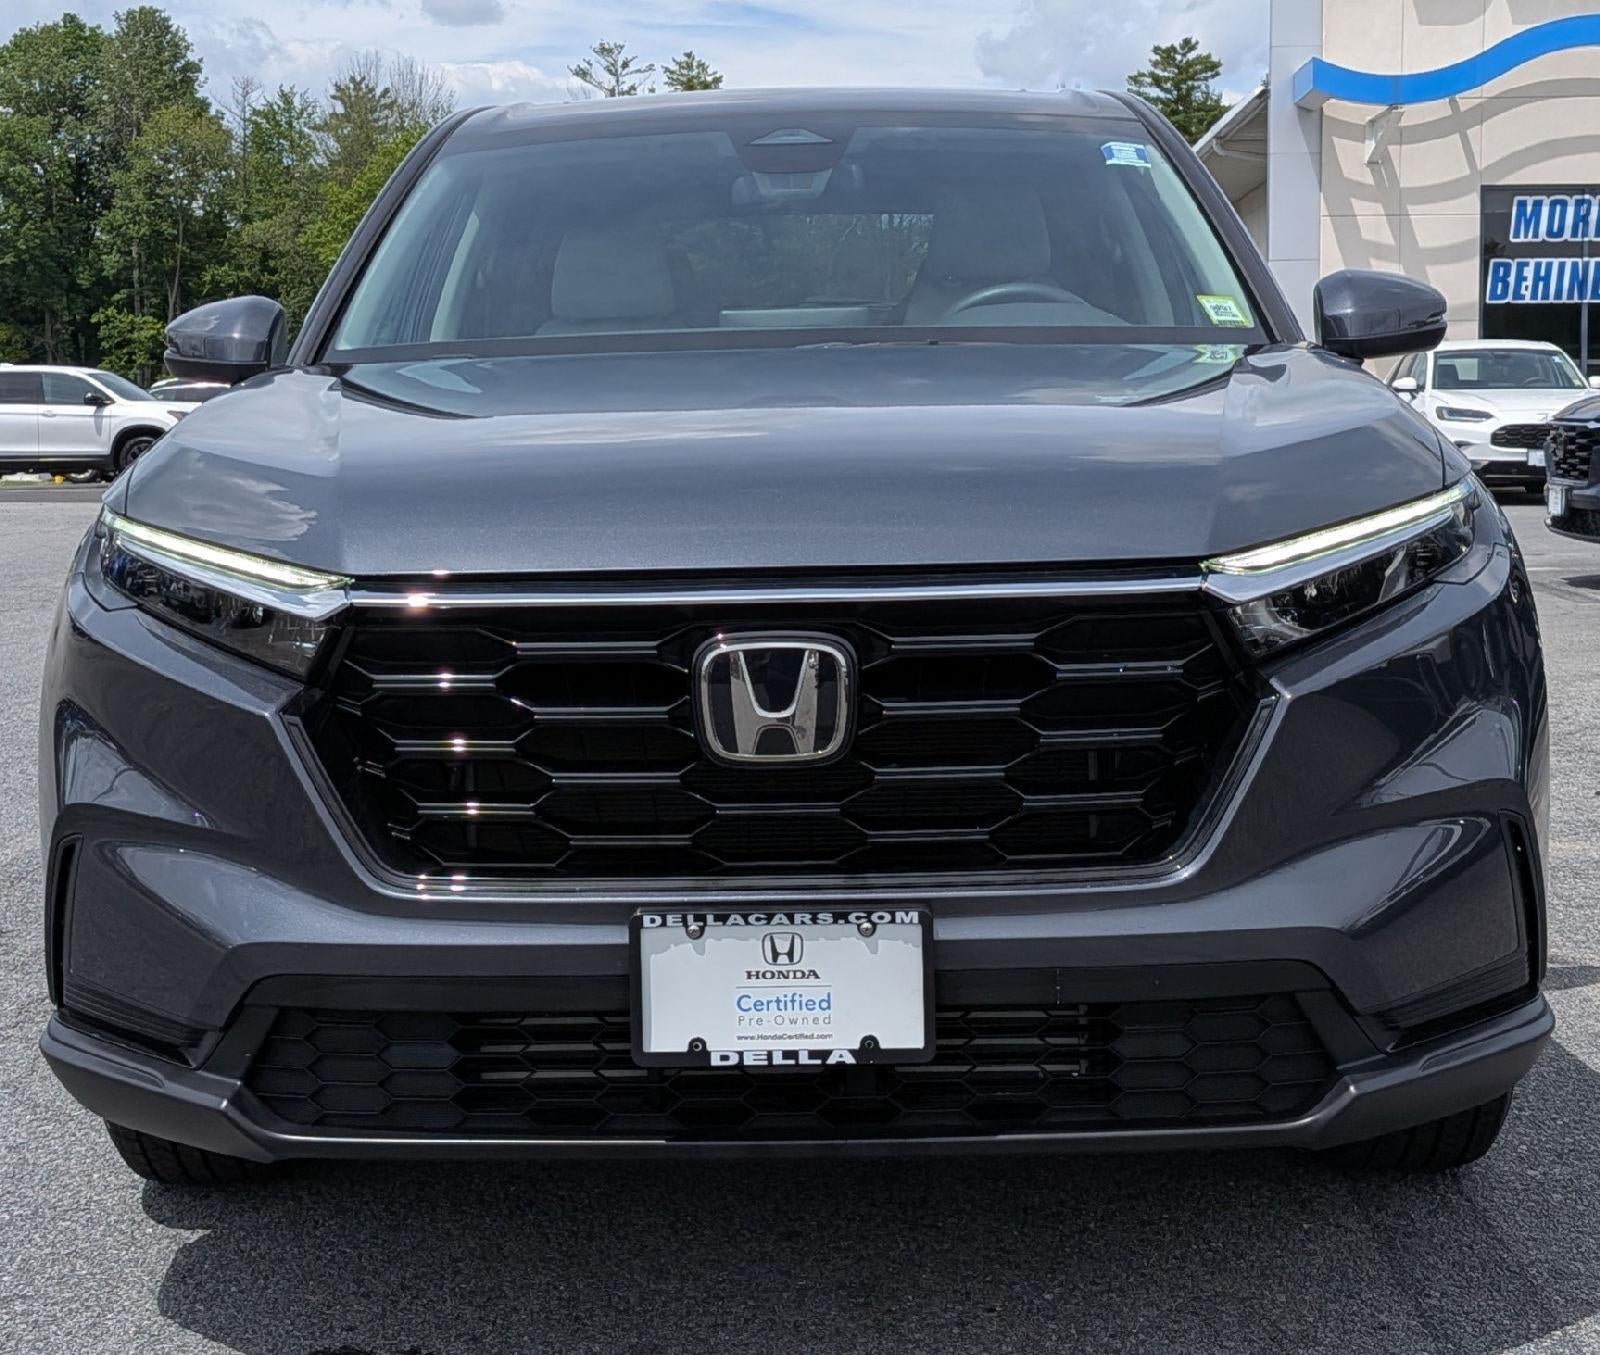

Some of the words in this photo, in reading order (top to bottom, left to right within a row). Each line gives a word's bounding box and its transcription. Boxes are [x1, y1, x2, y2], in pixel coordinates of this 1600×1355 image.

[1511, 196, 1600, 241] MOR
[643, 911, 920, 928] DELLACARS.COM
[745, 969, 820, 980] HONDA
[736, 991, 832, 1013] Certified
[737, 1014, 832, 1026] Pre-Owned
[736, 1032, 834, 1042] www.HondaCertified.com
[710, 1048, 858, 1067] DELLA
